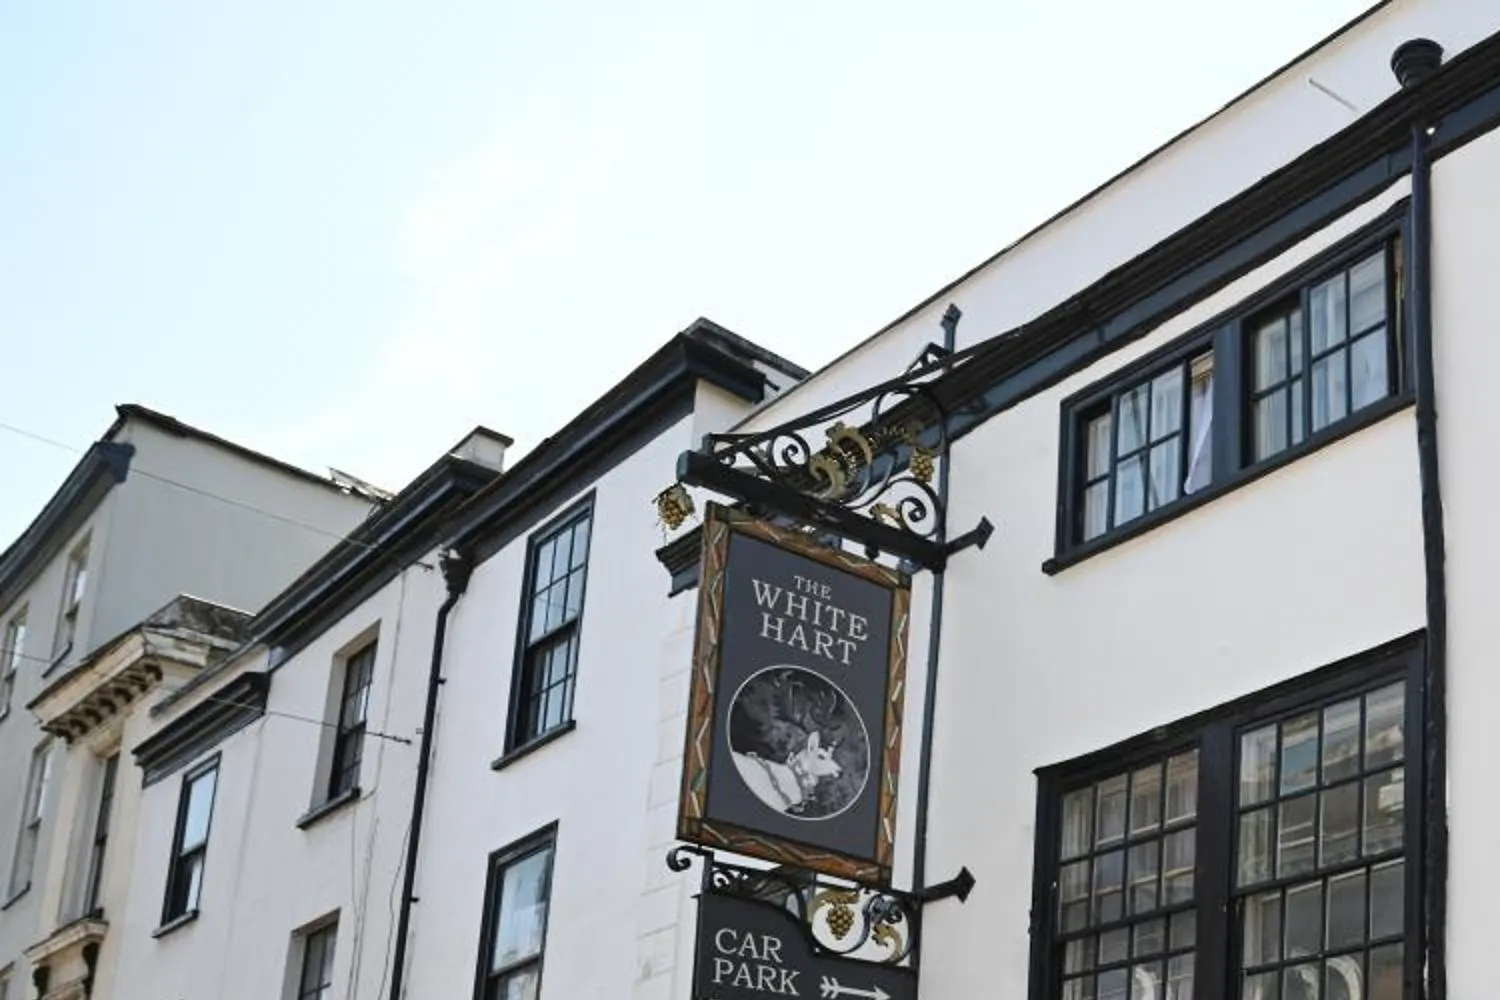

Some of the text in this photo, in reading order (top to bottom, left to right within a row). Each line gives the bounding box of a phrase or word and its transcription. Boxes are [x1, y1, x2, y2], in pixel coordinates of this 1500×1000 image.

[794, 575, 832, 600] THE
[752, 578, 868, 641] WHITE
[760, 611, 857, 665] HART
[715, 928, 782, 963] CAR
[712, 957, 800, 996] PARK
